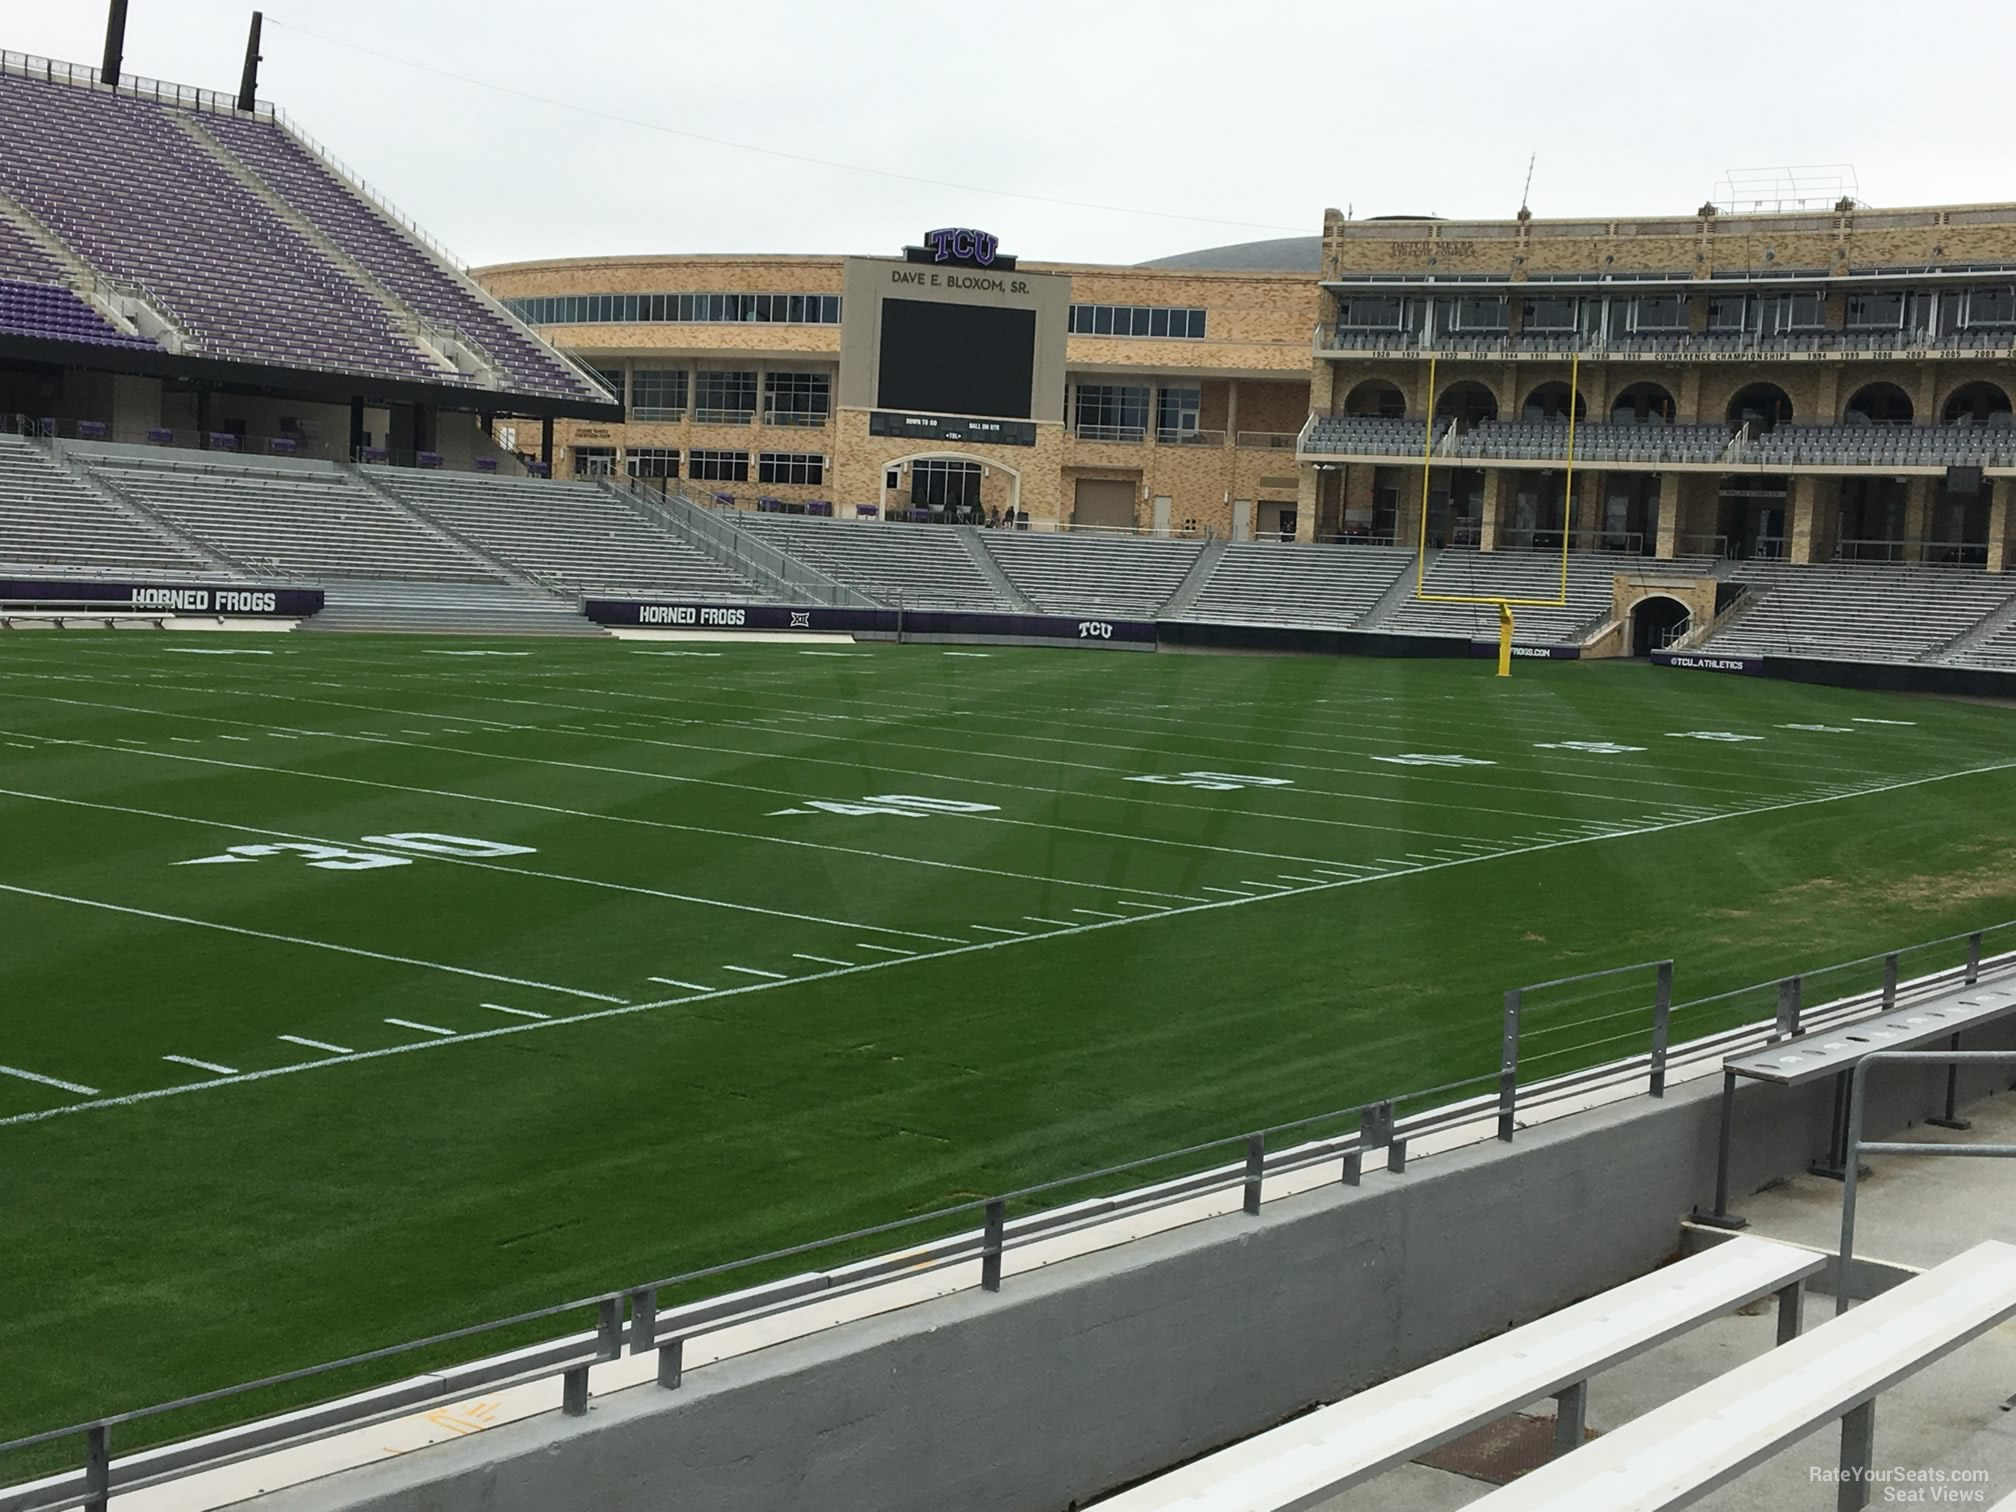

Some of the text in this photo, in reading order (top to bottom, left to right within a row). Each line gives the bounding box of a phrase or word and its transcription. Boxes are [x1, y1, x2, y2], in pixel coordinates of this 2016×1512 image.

[931, 227, 999, 266] TCU
[892, 270, 1030, 294] DAVE E. BLOXOM, SR.
[1654, 352, 1712, 361] CONFERENCE
[1715, 352, 1791, 361] CHAMPIONSHIPS
[1872, 351, 1894, 360] 2000
[1905, 350, 1927, 360] 2002
[1940, 350, 1961, 359] 2005
[1974, 350, 1996, 359] 2009
[215, 591, 276, 612] FROGS
[639, 605, 746, 626] HORNED FROGS
[1078, 621, 1113, 640] TCU
[1670, 657, 1744, 670] @TCU_ATHLETICS
